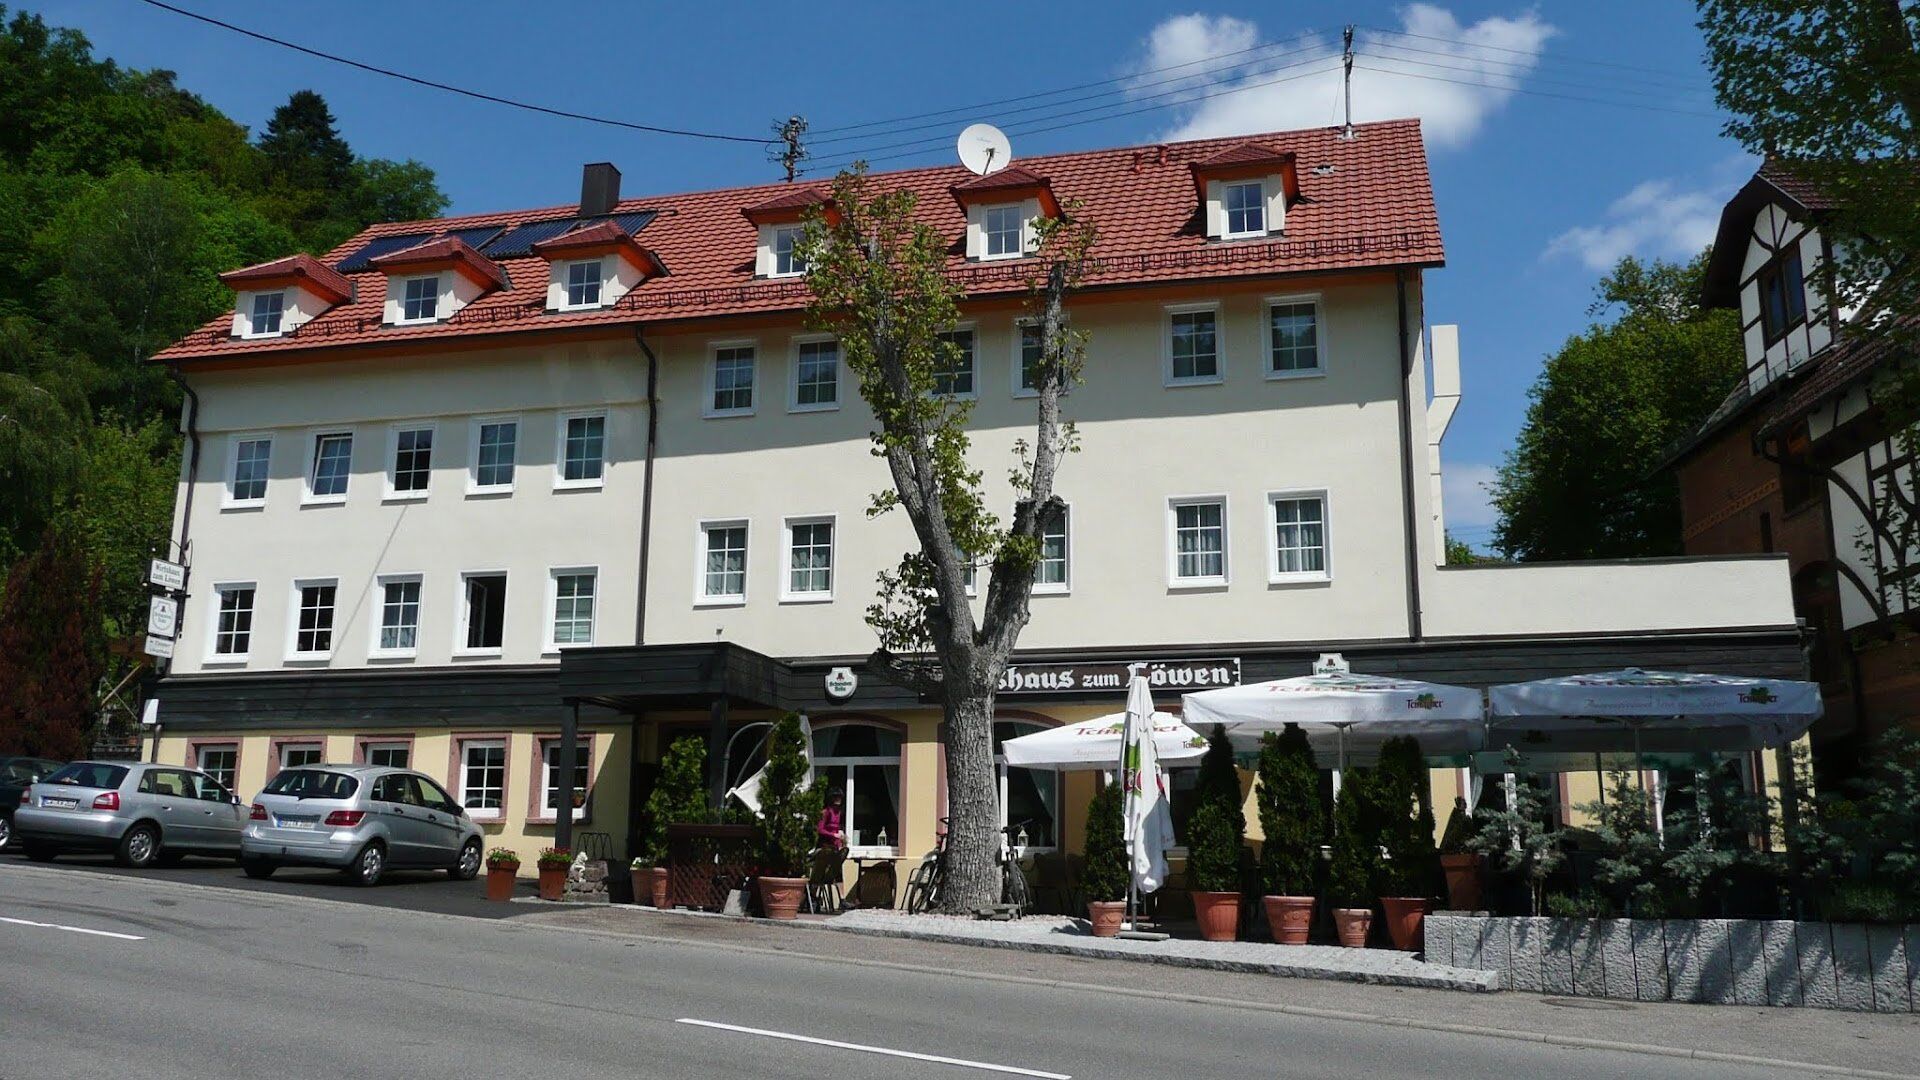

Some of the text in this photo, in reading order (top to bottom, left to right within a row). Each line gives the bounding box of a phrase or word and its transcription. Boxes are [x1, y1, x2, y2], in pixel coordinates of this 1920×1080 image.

[998, 662, 1231, 691] shaus zum Löwen
